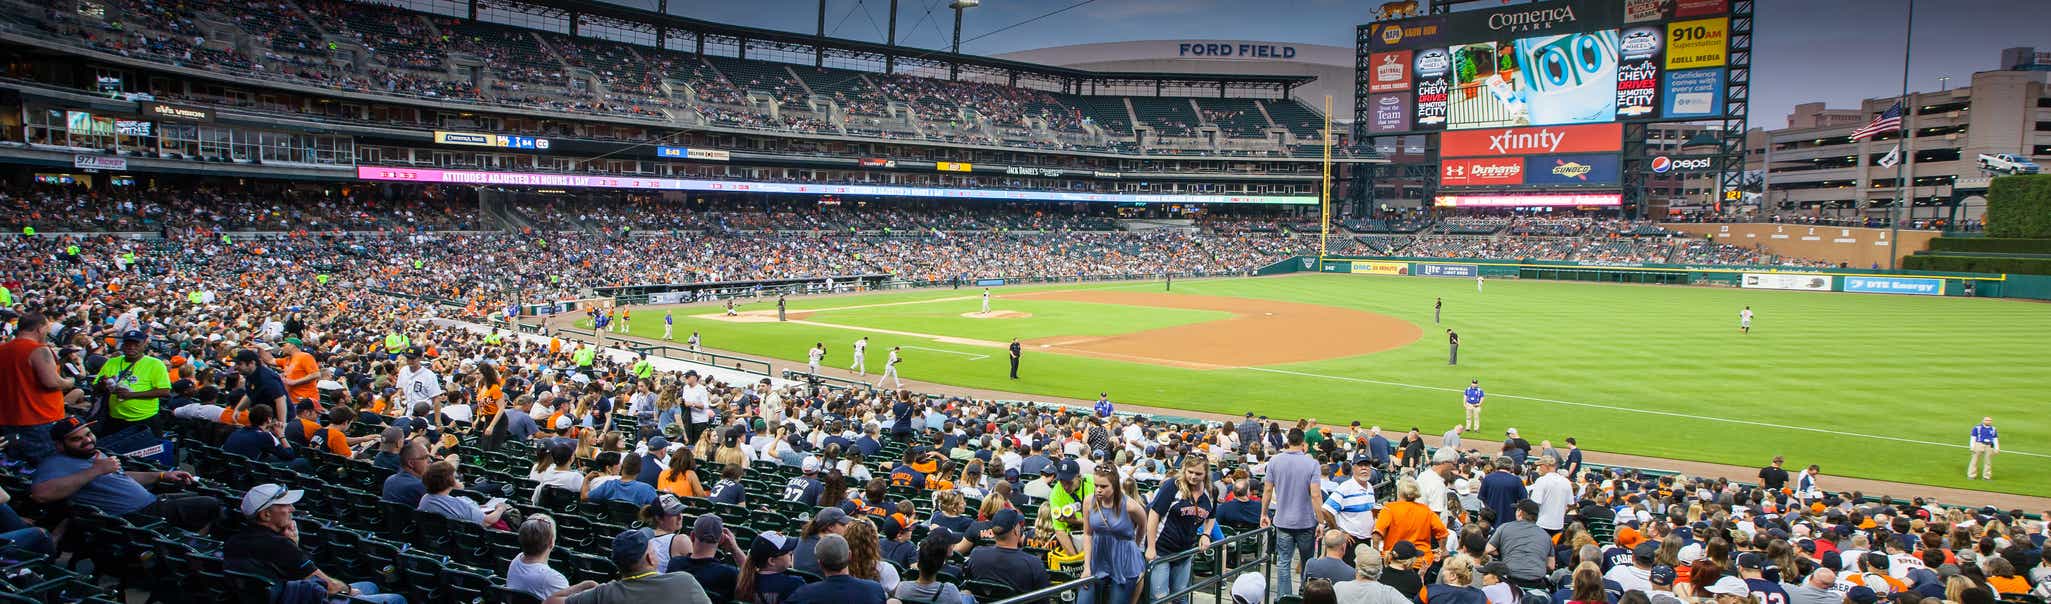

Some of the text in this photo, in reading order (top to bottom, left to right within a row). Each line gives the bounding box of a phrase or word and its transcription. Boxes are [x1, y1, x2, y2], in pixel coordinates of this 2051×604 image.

[1511, 21, 1552, 32] PARK
[1672, 26, 1722, 41] 910 AM
[1179, 43, 1296, 58] FORD FIELD
[1695, 54, 1720, 62] MEDIA
[1618, 70, 1656, 81] CHEVY
[1618, 79, 1656, 91] DRIVES
[1419, 86, 1447, 96] CHEVY
[1626, 88, 1655, 97] MOTOR
[1418, 94, 1447, 103] DRIVES
[1626, 94, 1655, 107] CITY
[1377, 110, 1401, 120] Team
[1425, 107, 1446, 116] CITY
[537, 140, 548, 148] CC
[1489, 128, 1566, 154] xfinity
[1671, 157, 1711, 171] pepsi
[1007, 165, 1019, 175] JACK
[1019, 166, 1039, 176] DANIEL'S
[1471, 163, 1521, 177] Dunham's
[442, 172, 487, 183] ATTITUDES
[488, 174, 530, 184] ADJUSTED
[1425, 265, 1440, 275] Lite
[1891, 281, 1933, 292] Energy
[711, 484, 725, 498] 3
[783, 486, 804, 502] 27
